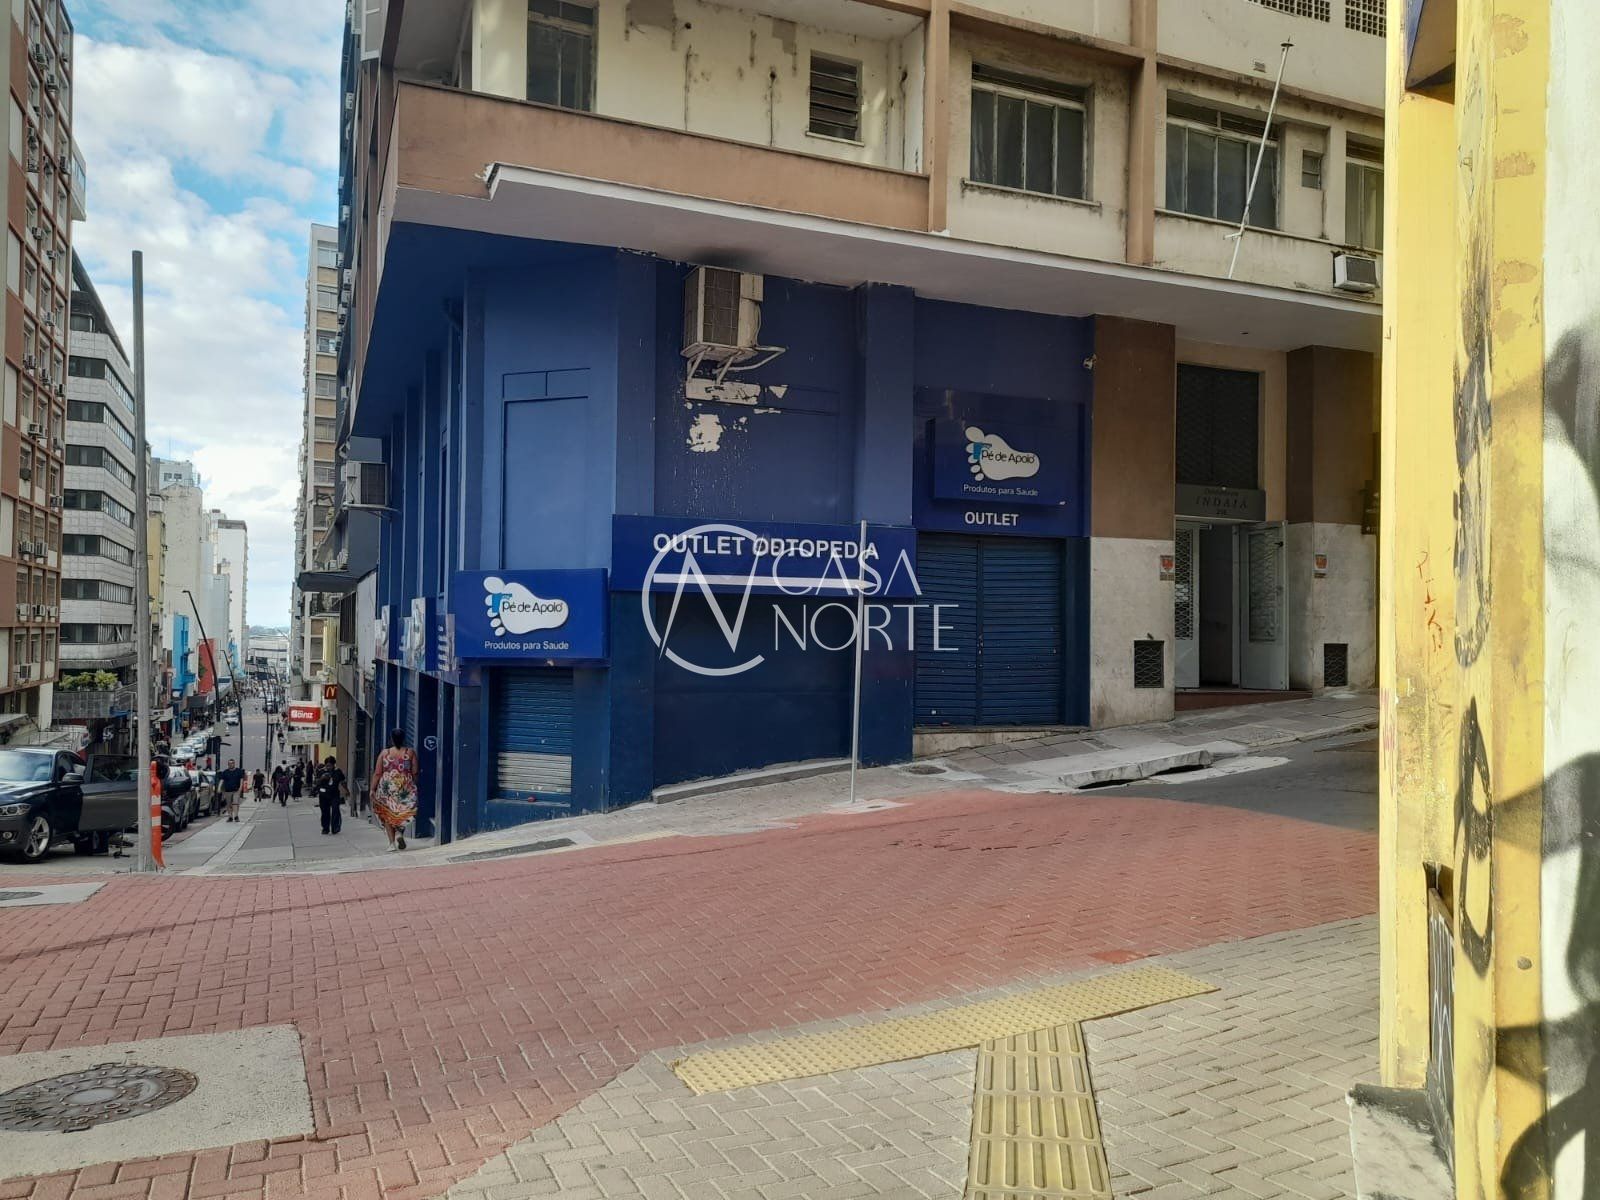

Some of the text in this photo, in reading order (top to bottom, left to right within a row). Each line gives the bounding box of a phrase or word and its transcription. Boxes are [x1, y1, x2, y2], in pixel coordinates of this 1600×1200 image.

[995, 452, 1008, 462] de
[963, 483, 997, 494] Produtos
[998, 487, 1015, 497] para
[964, 511, 1019, 527] OUTLET
[653, 532, 880, 560] OUTLET OTOPEDA
[518, 601, 531, 613] de
[484, 640, 521, 650] Produtos
[523, 642, 541, 652] para
